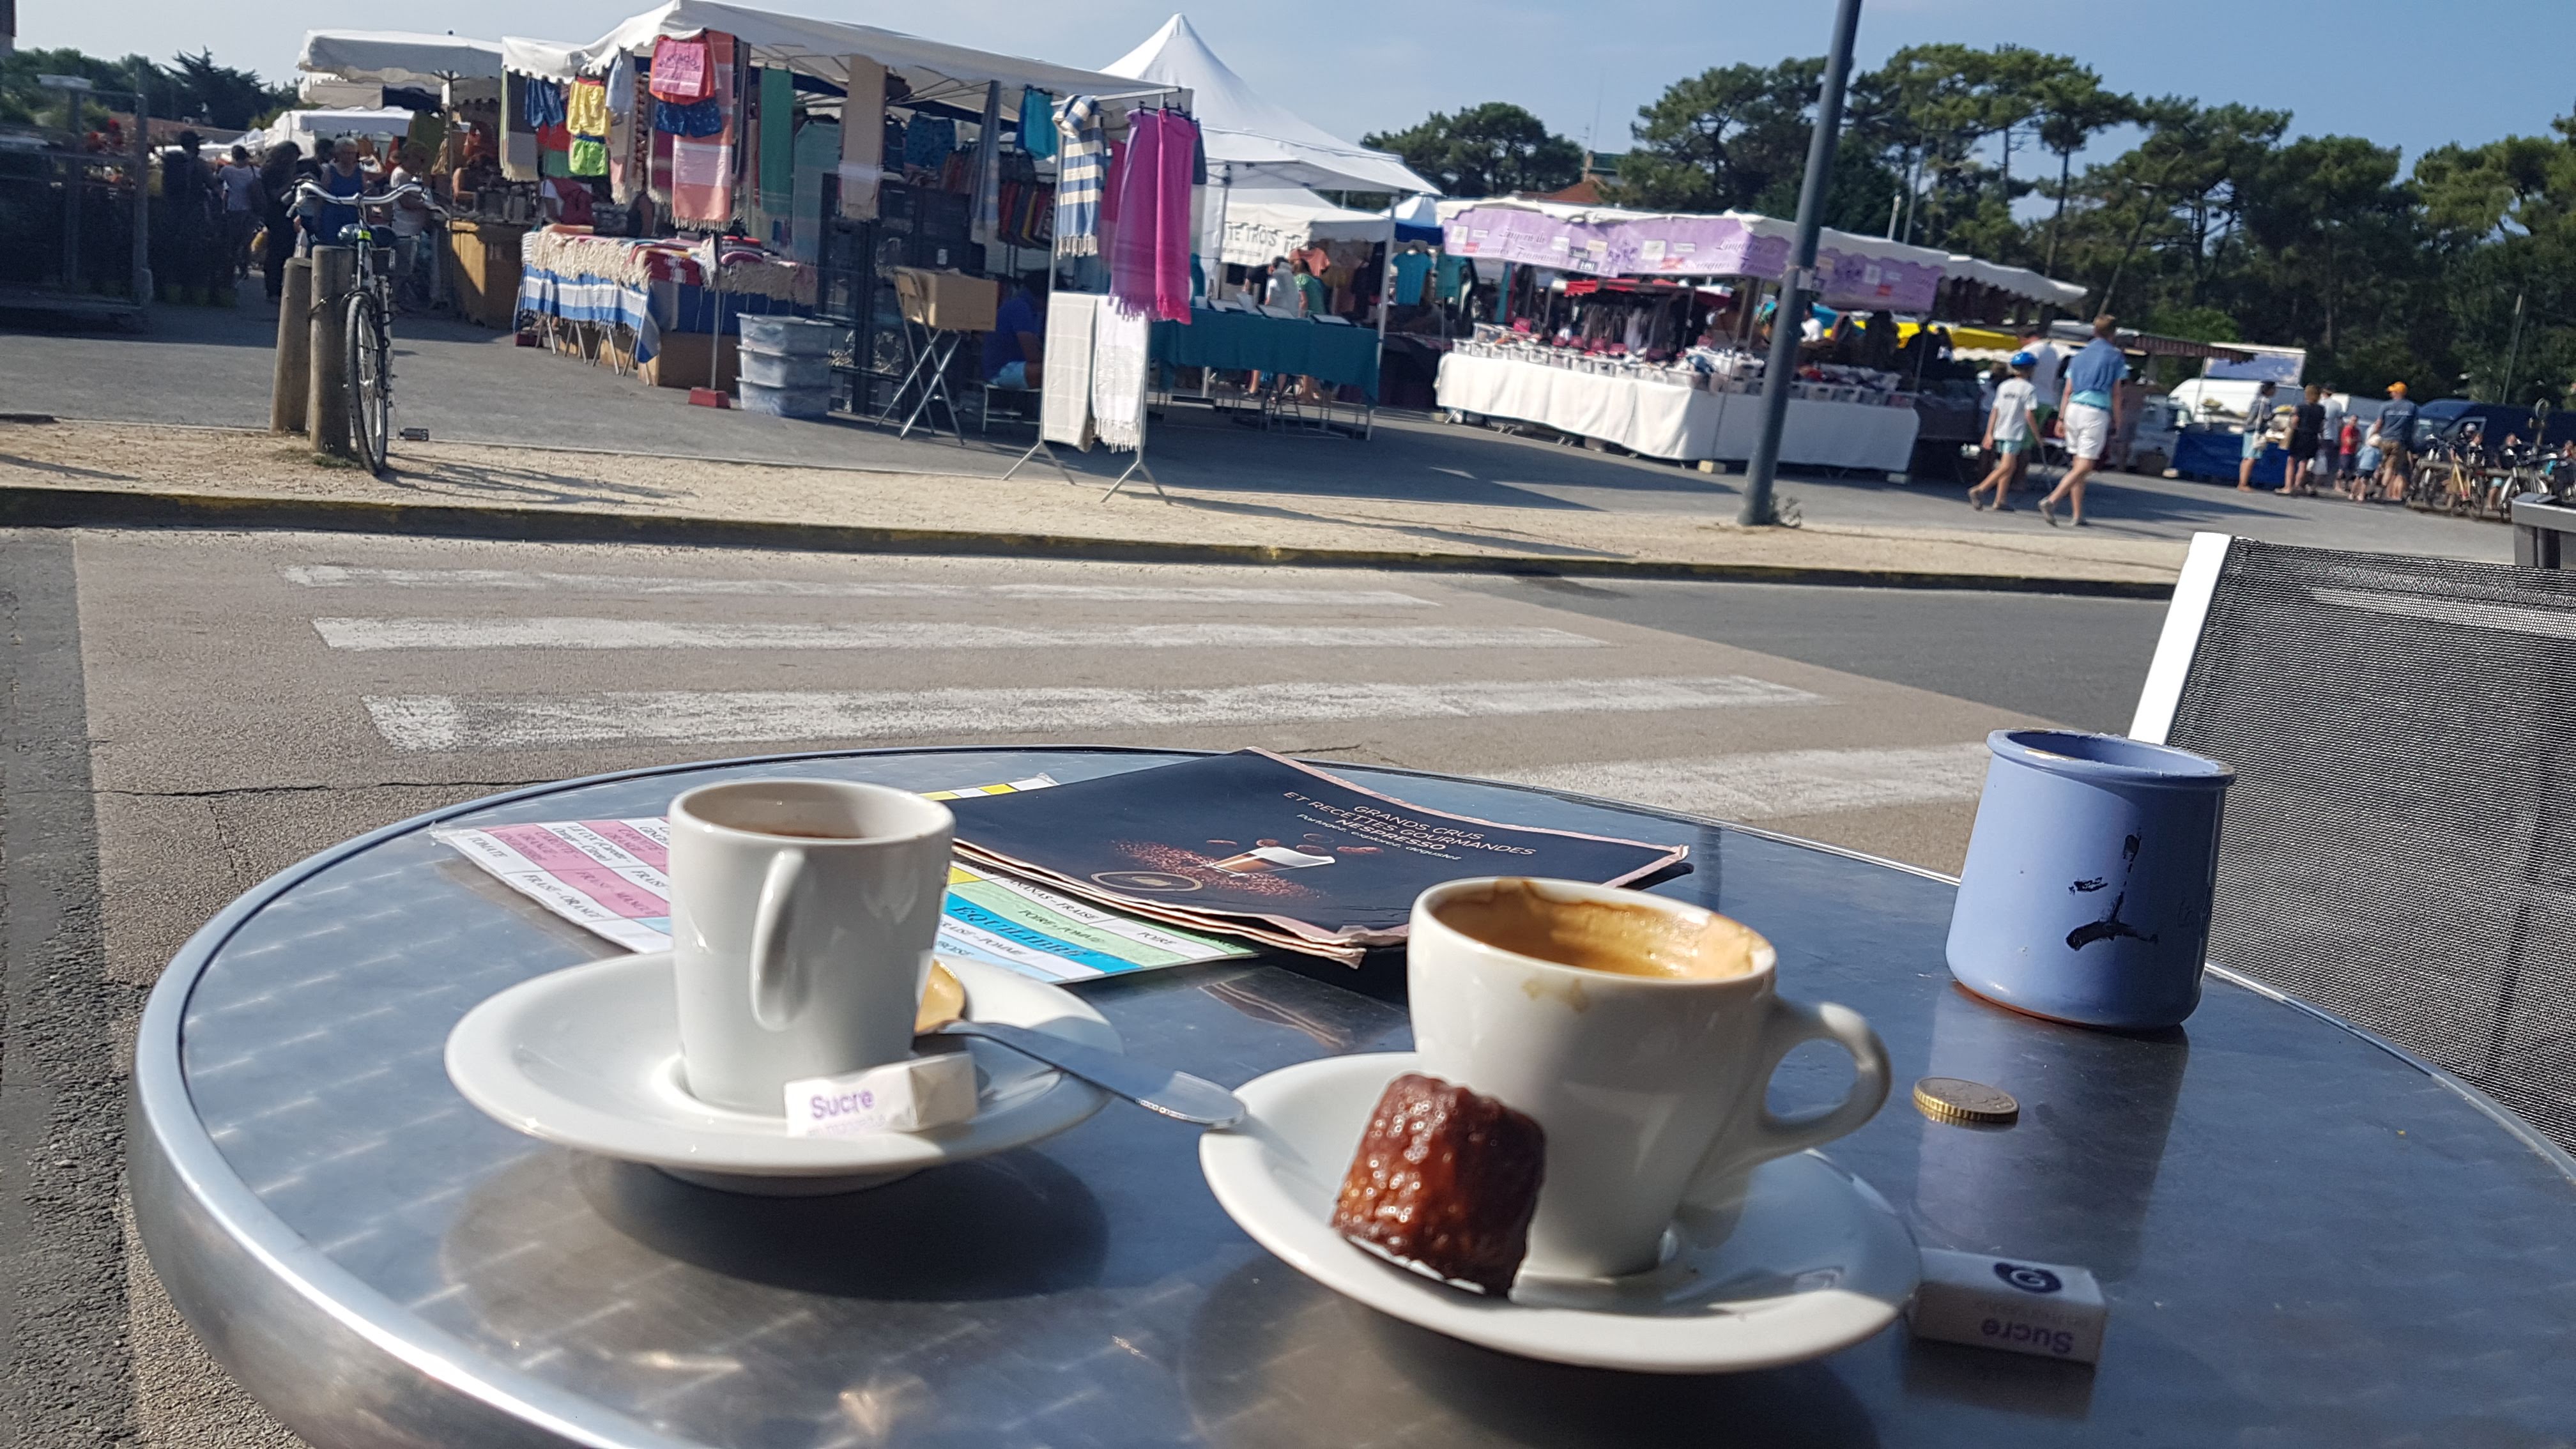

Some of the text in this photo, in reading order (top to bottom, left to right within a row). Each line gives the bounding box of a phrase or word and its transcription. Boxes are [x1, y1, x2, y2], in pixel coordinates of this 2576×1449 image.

[1283, 791, 1537, 855] ET RECETTES GOURMANDES
[1335, 819, 1447, 851] NESPRESSO
[1354, 806, 1485, 840] GRANDS CRUS
[467, 837, 509, 858] TOMATE
[522, 875, 562, 891] FRAISE
[559, 895, 606, 918] ORANGE
[1004, 879, 1054, 900] ANANAS
[1056, 902, 1100, 919] FRAISE
[1018, 909, 1057, 925] POIRE
[1057, 926, 1105, 944] POMME
[1136, 931, 1178, 946] POIRE
[978, 938, 1027, 954] POMME
[810, 1089, 875, 1119] Sucre
[1981, 1316, 2074, 1355] Sucre
